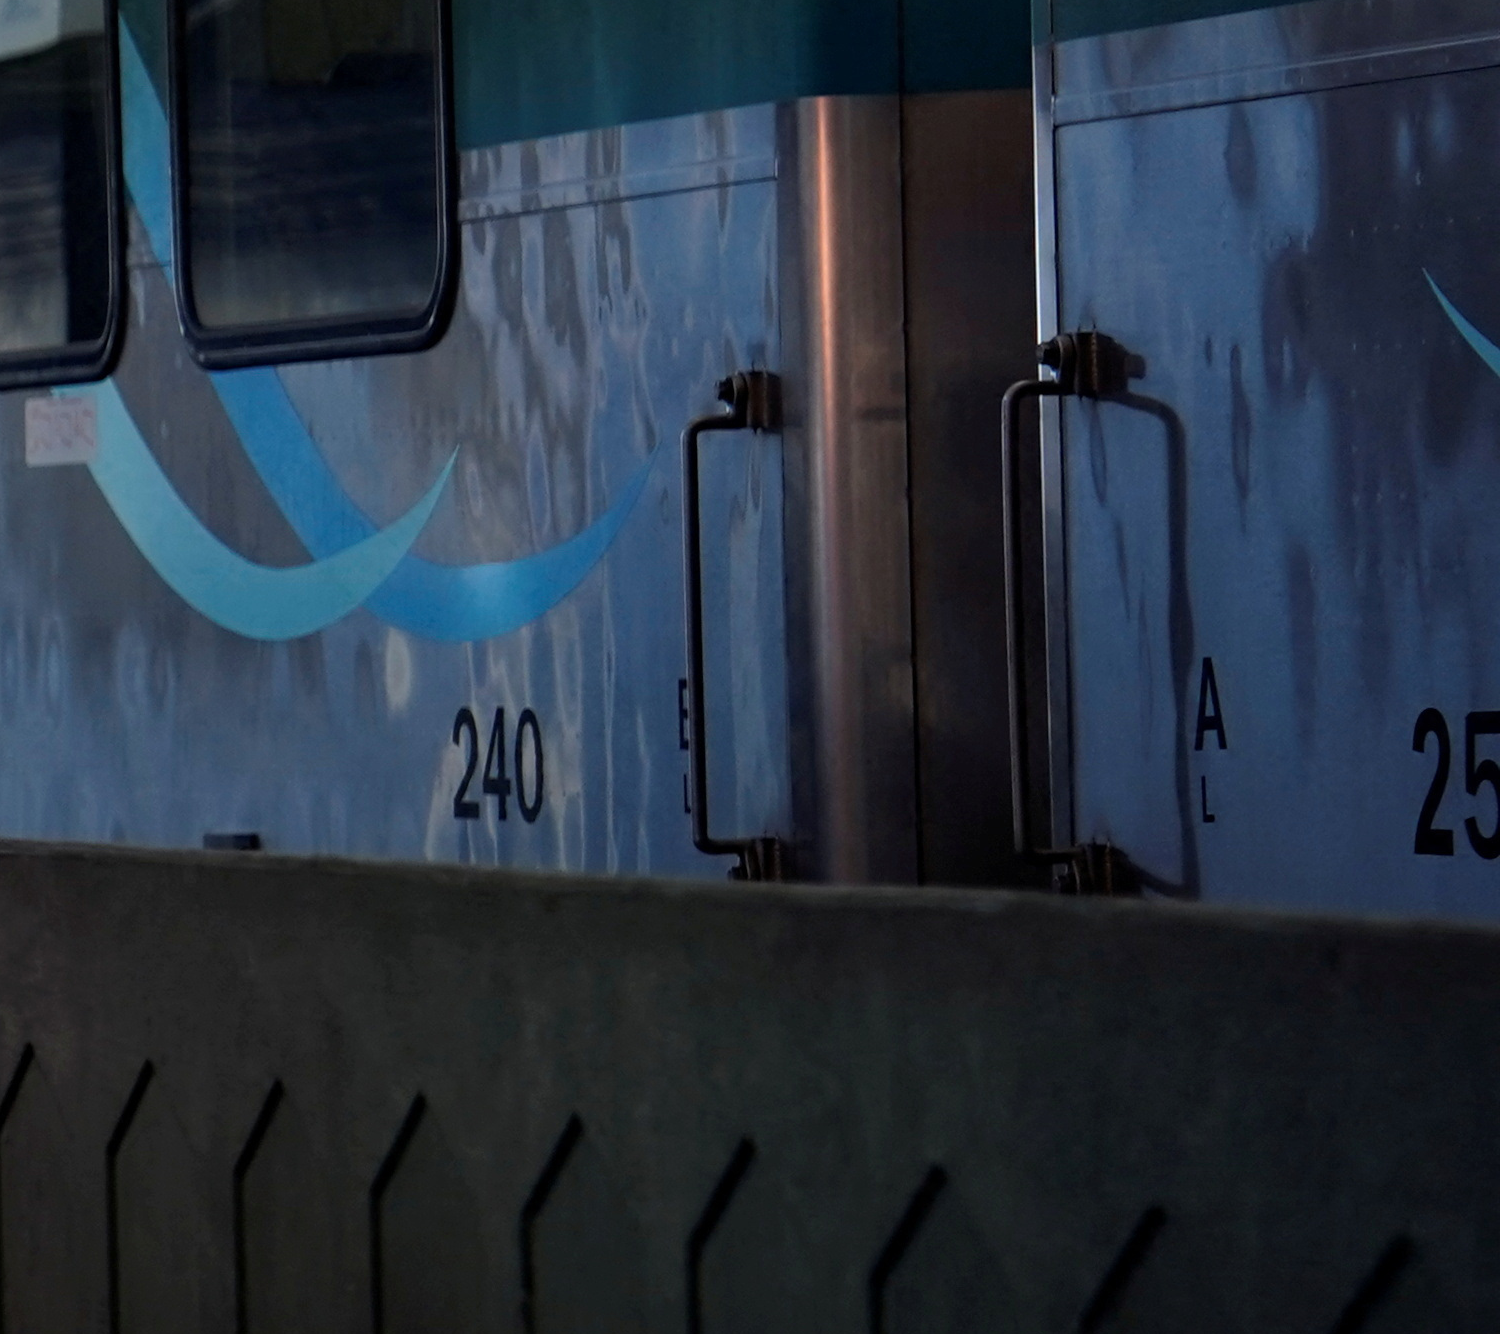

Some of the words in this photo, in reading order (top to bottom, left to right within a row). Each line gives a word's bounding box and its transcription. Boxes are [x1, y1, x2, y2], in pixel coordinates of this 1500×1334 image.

[1194, 656, 1228, 752] A
[452, 706, 544, 823] 240
[1201, 775, 1216, 823] L
[1412, 706, 1500, 860] 25
